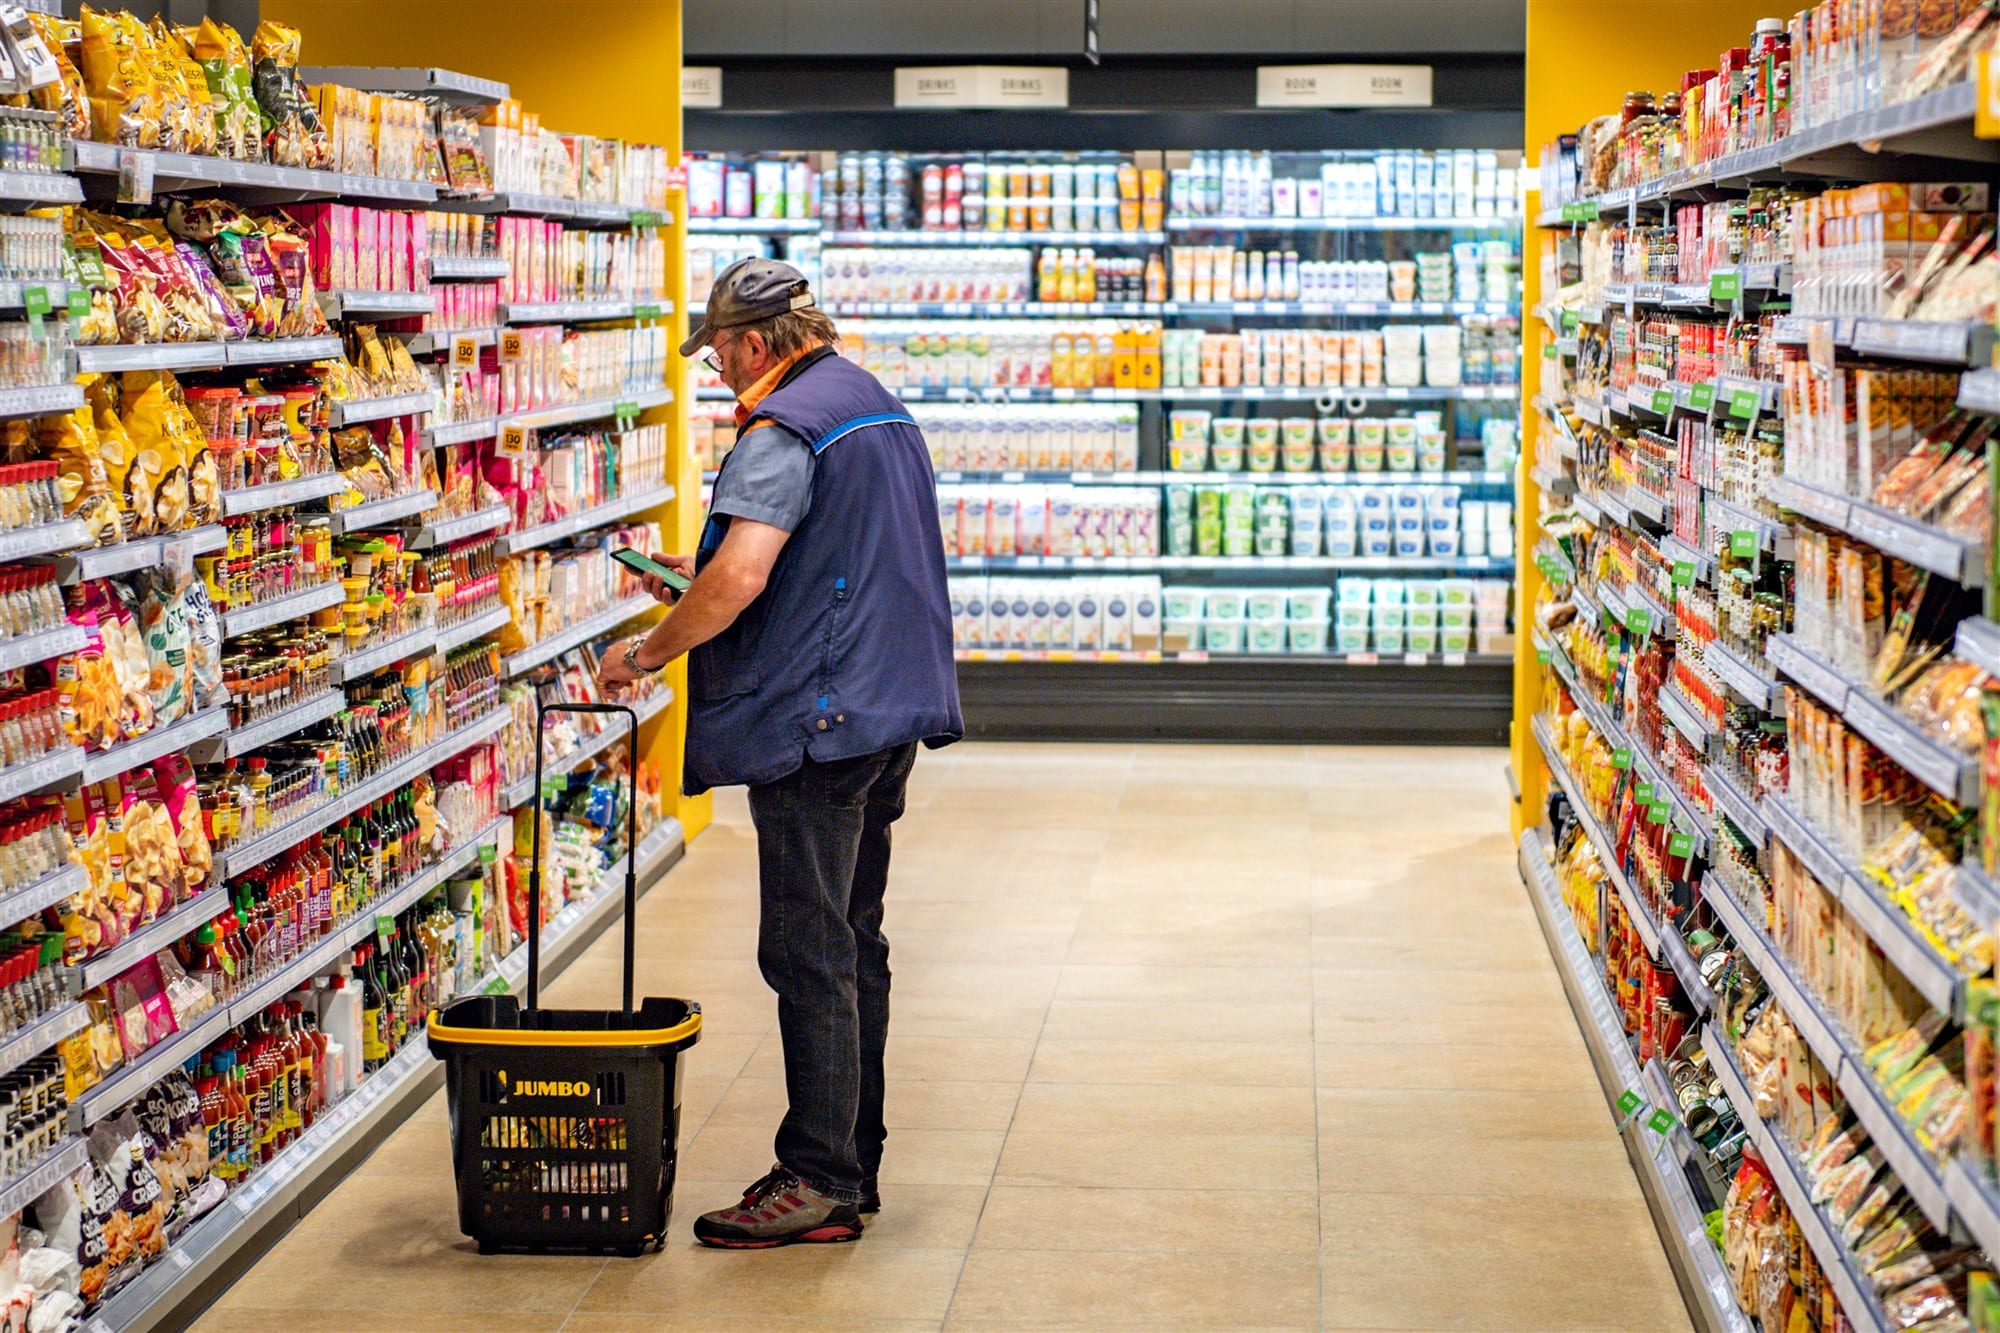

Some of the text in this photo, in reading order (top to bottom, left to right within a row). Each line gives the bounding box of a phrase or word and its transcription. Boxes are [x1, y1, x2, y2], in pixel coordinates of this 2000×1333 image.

[917, 79, 957, 91] DRINKS
[1001, 78, 1042, 91] DRINKS
[1285, 77, 1317, 90] ROOM
[1371, 76, 1402, 89] ROOM
[1720, 281, 1736, 290] BIO
[505, 340, 520, 350] 130
[458, 346, 473, 356] 130
[1695, 389, 1710, 399] BIO
[1656, 396, 1670, 406] BIO
[1736, 397, 1753, 409] BIO
[505, 433, 521, 444] 130
[1736, 538, 1752, 547] BIO
[1676, 567, 1691, 577] BIO
[1616, 754, 1628, 762] BIO
[1652, 806, 1666, 816] BIO
[1675, 841, 1689, 849] BIO
[513, 1080, 591, 1097] JUMBO
[1623, 1095, 1636, 1107] BIO
[1655, 1115, 1669, 1127] BIO
